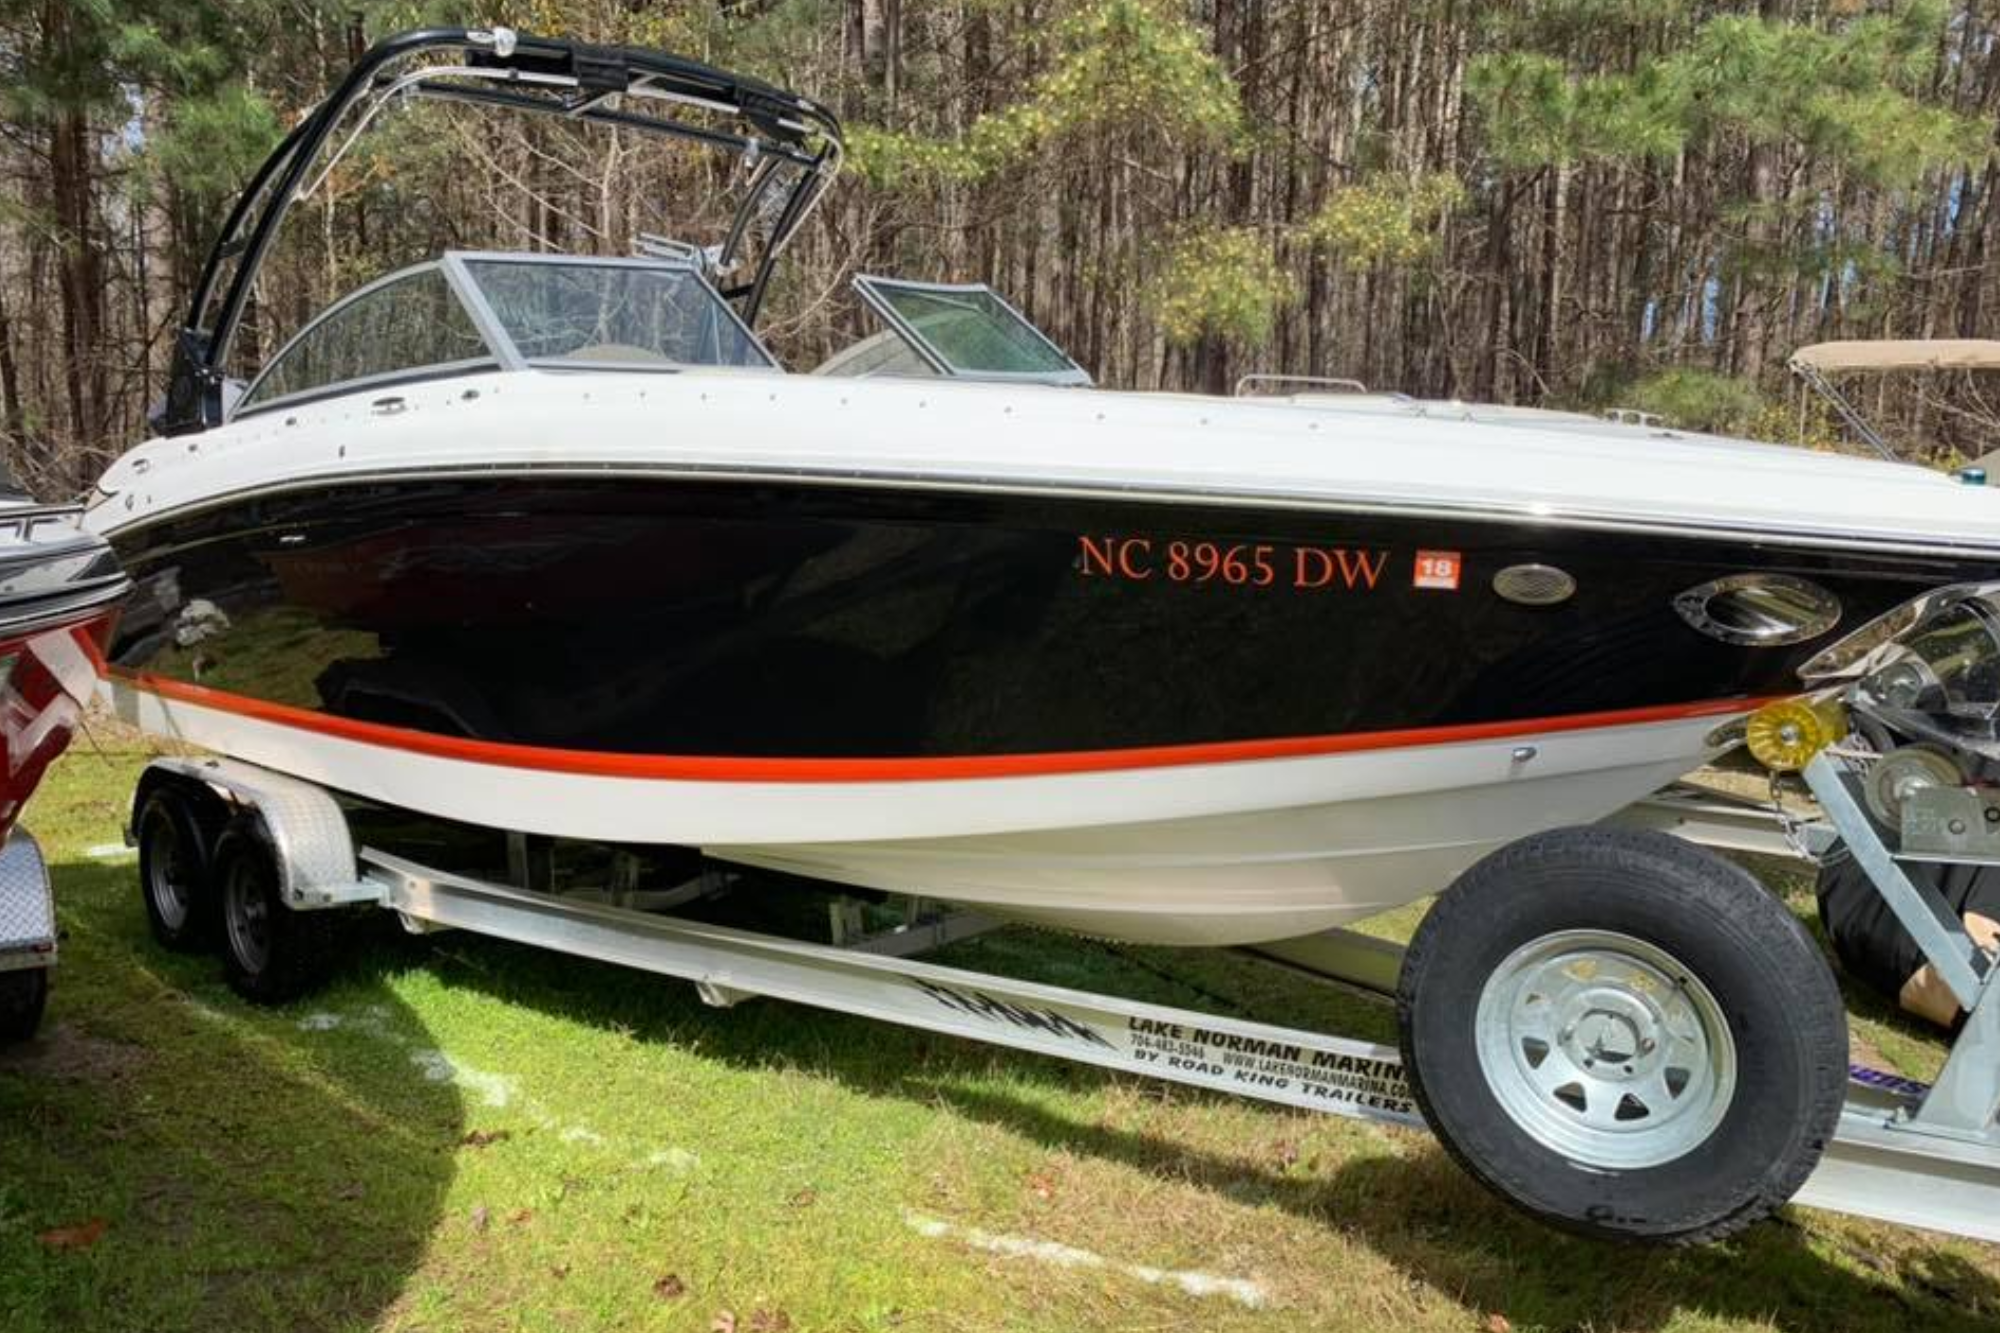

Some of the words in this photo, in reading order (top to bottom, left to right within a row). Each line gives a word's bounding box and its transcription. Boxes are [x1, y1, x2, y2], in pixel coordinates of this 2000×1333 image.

[1079, 536, 1153, 579] NC
[1168, 541, 1275, 586] 8965
[1293, 547, 1390, 589] DW
[1422, 558, 1452, 577] 18
[1128, 1016, 1184, 1039] LAKE
[1193, 1028, 1301, 1062] NORMAN
[1134, 1049, 1159, 1062] BY
[1168, 1056, 1225, 1076] ROAD
[1234, 1069, 1290, 1090] KING
[1301, 1081, 1413, 1113] TRAILERS
